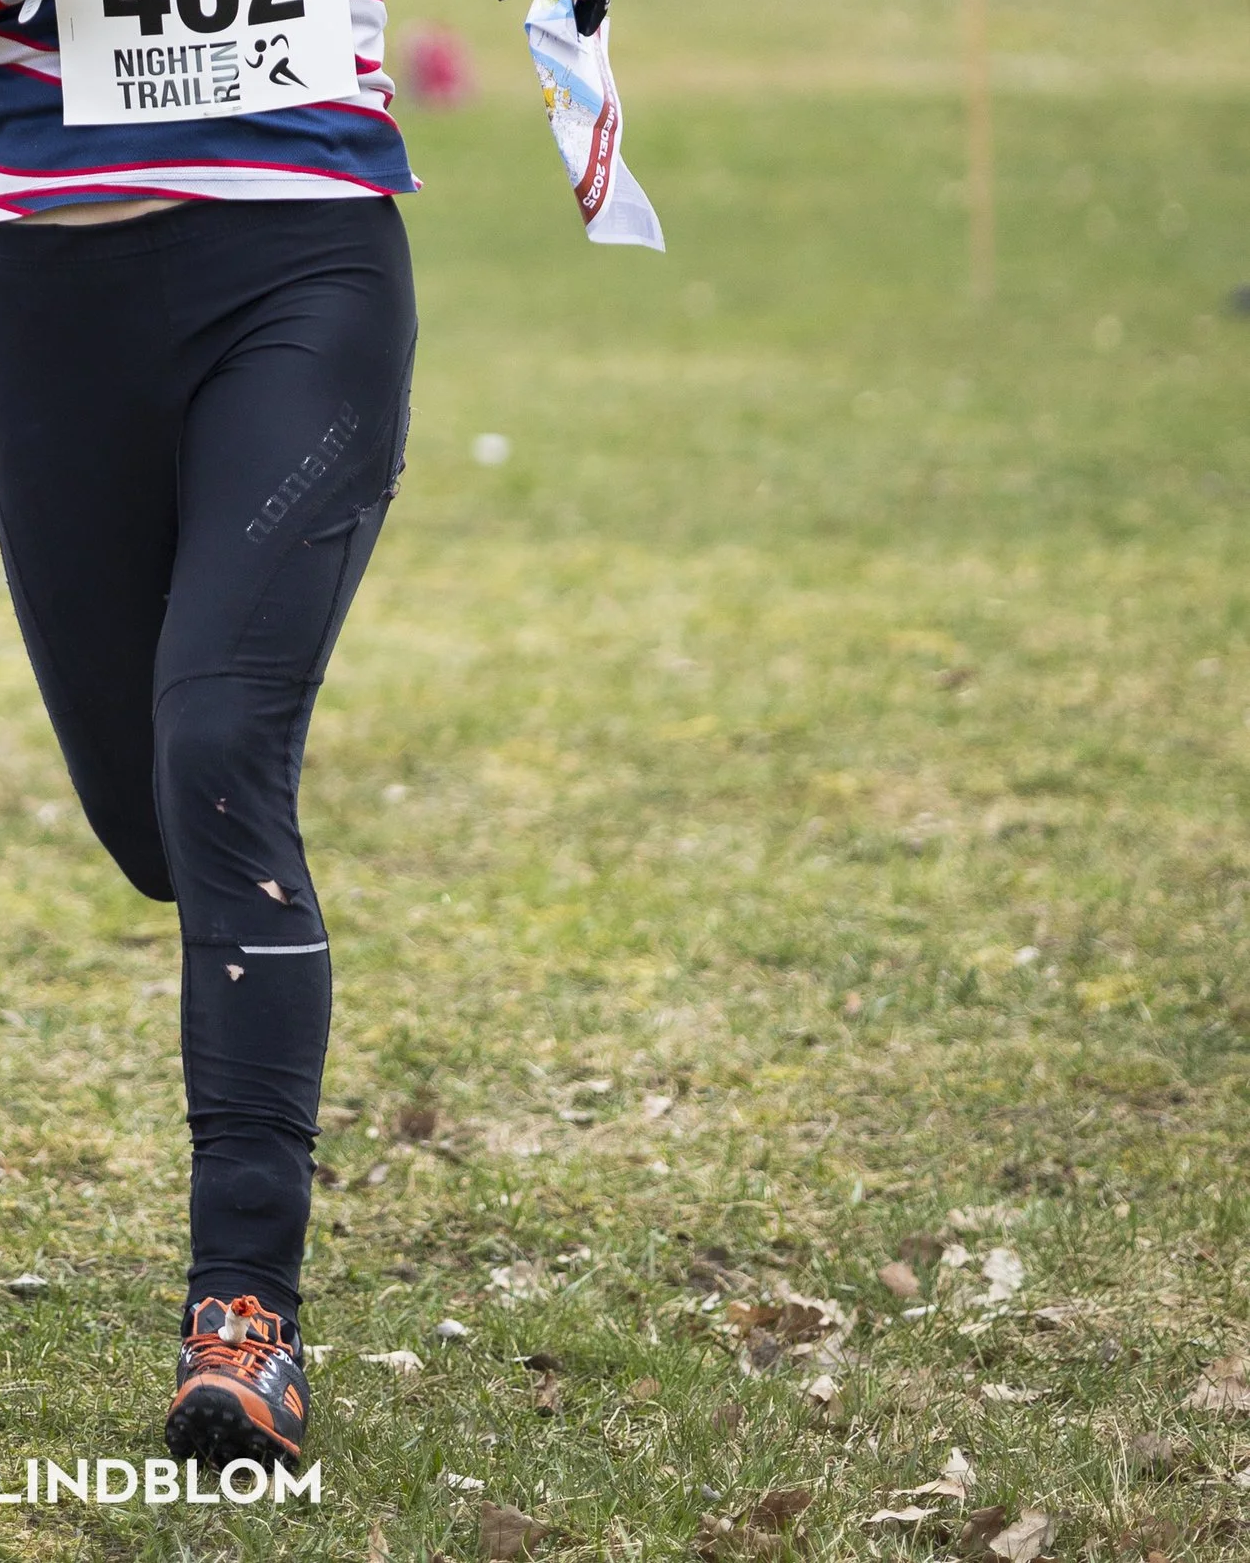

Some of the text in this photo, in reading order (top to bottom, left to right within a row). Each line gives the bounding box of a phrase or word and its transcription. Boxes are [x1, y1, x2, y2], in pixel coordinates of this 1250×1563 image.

[113, 44, 207, 78] NIGHT
[209, 41, 241, 103] RUN
[117, 78, 212, 110] TRAIL
[597, 105, 616, 160] MEDEL
[582, 165, 606, 209] 2025
